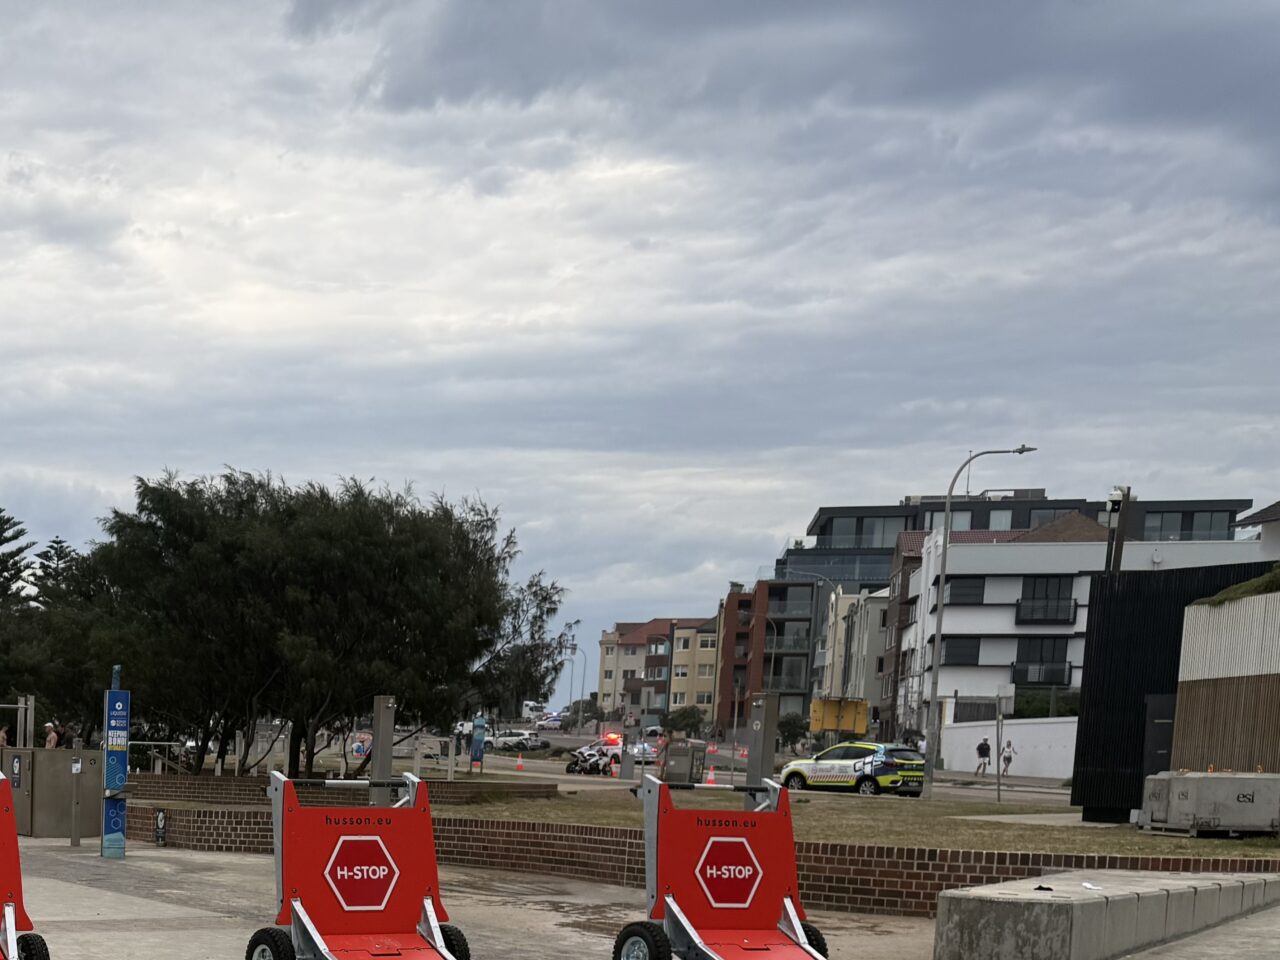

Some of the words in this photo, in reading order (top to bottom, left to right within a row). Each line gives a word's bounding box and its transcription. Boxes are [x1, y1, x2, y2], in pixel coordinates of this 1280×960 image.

[1236, 791, 1255, 803] esi
[325, 815, 392, 825] husson.eu
[696, 817, 757, 828] husson.eu
[336, 865, 389, 880] H-STOP
[706, 865, 754, 879] H-STOP
